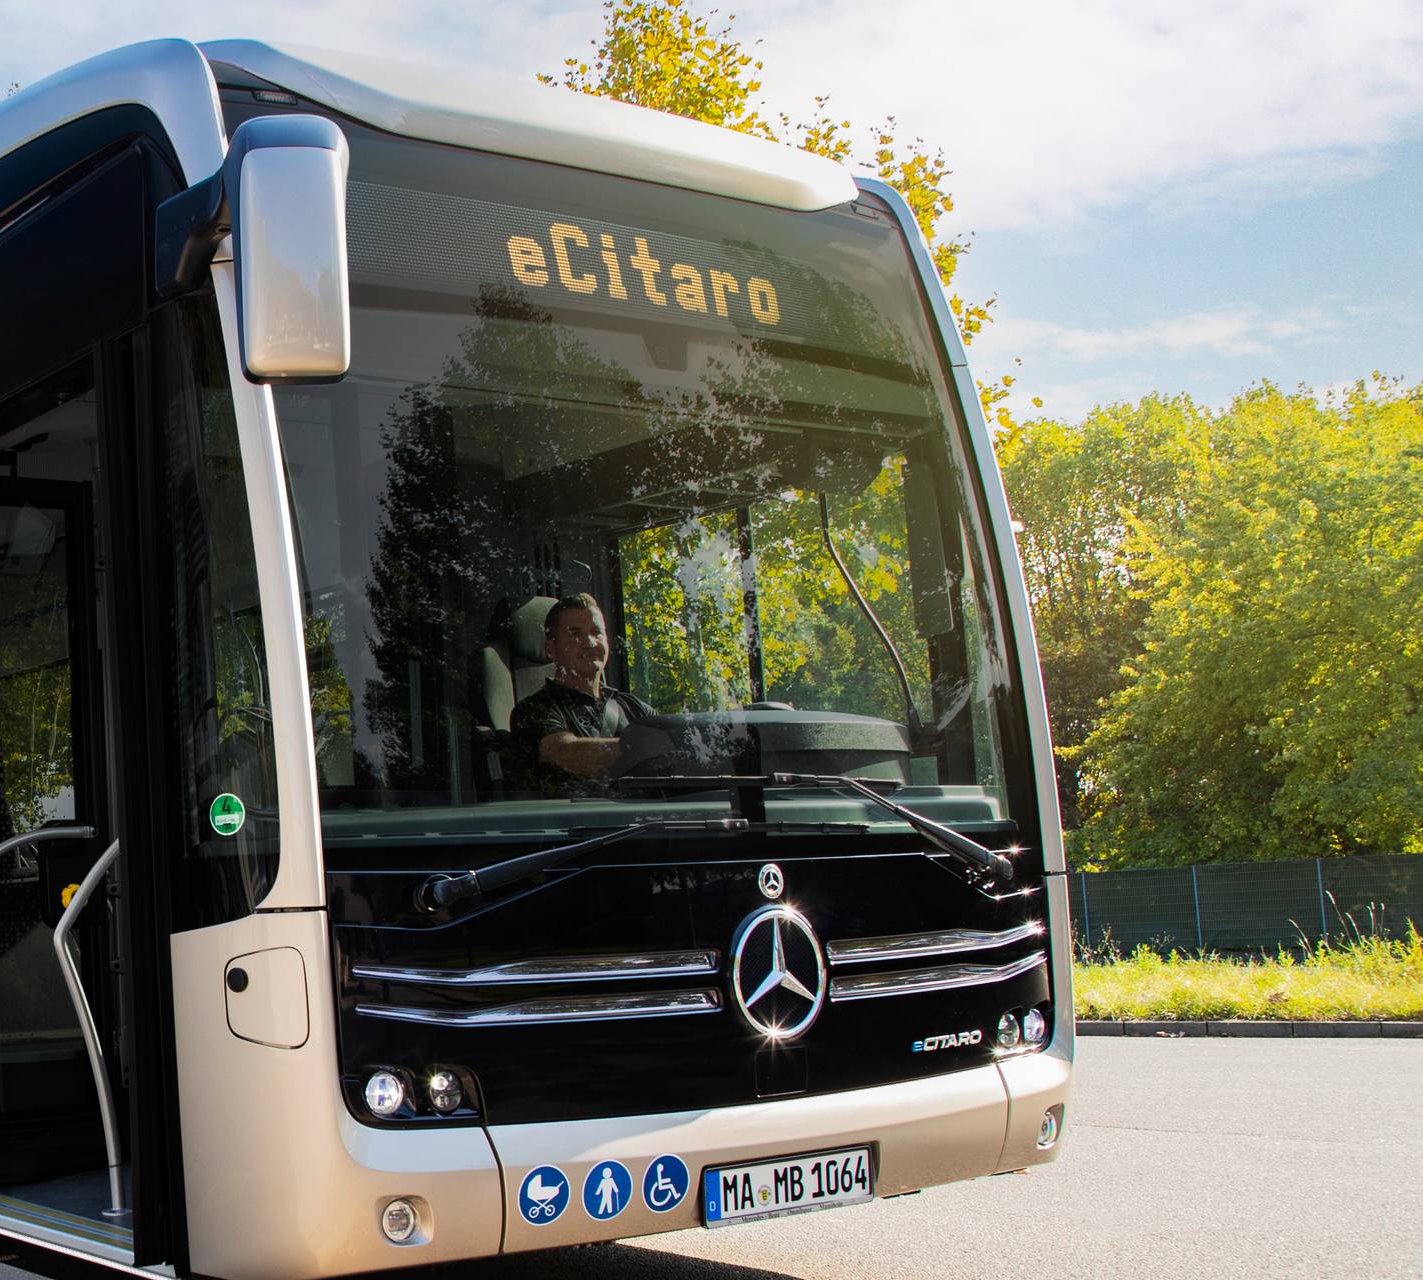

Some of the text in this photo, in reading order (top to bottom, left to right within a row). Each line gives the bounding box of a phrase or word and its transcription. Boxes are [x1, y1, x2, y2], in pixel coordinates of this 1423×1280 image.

[507, 222, 780, 326] eCitaro
[222, 797, 232, 814] 4
[912, 1029, 983, 1053] eCITARO
[709, 1155, 867, 1212] D MA MB 1064
